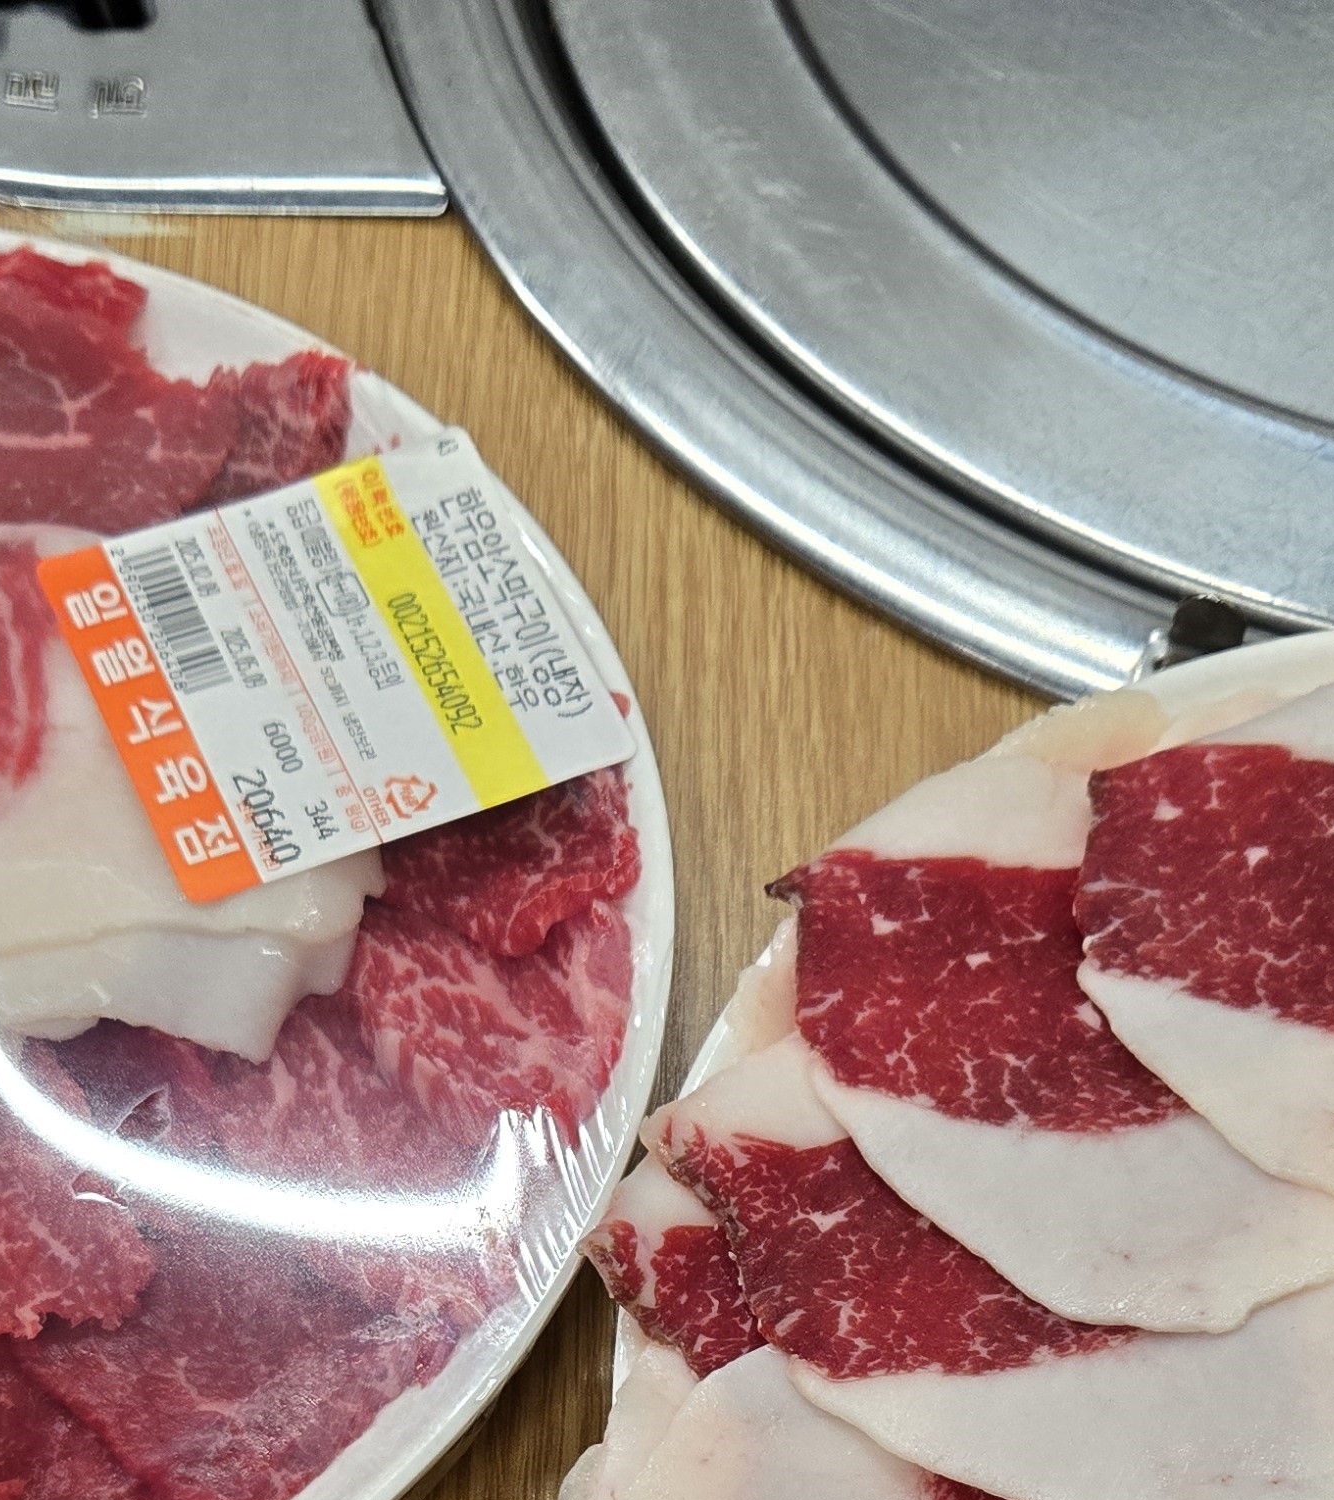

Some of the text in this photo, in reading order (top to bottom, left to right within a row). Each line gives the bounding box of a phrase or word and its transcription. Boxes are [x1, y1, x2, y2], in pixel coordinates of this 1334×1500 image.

[384, 590, 484, 736] 002152654092
[438, 484, 597, 724] 한우암소막구이(냉장)
[231, 767, 304, 867] 20640
[261, 718, 305, 775] 6000
[302, 799, 341, 841] 344
[361, 785, 392, 827] OTHER
